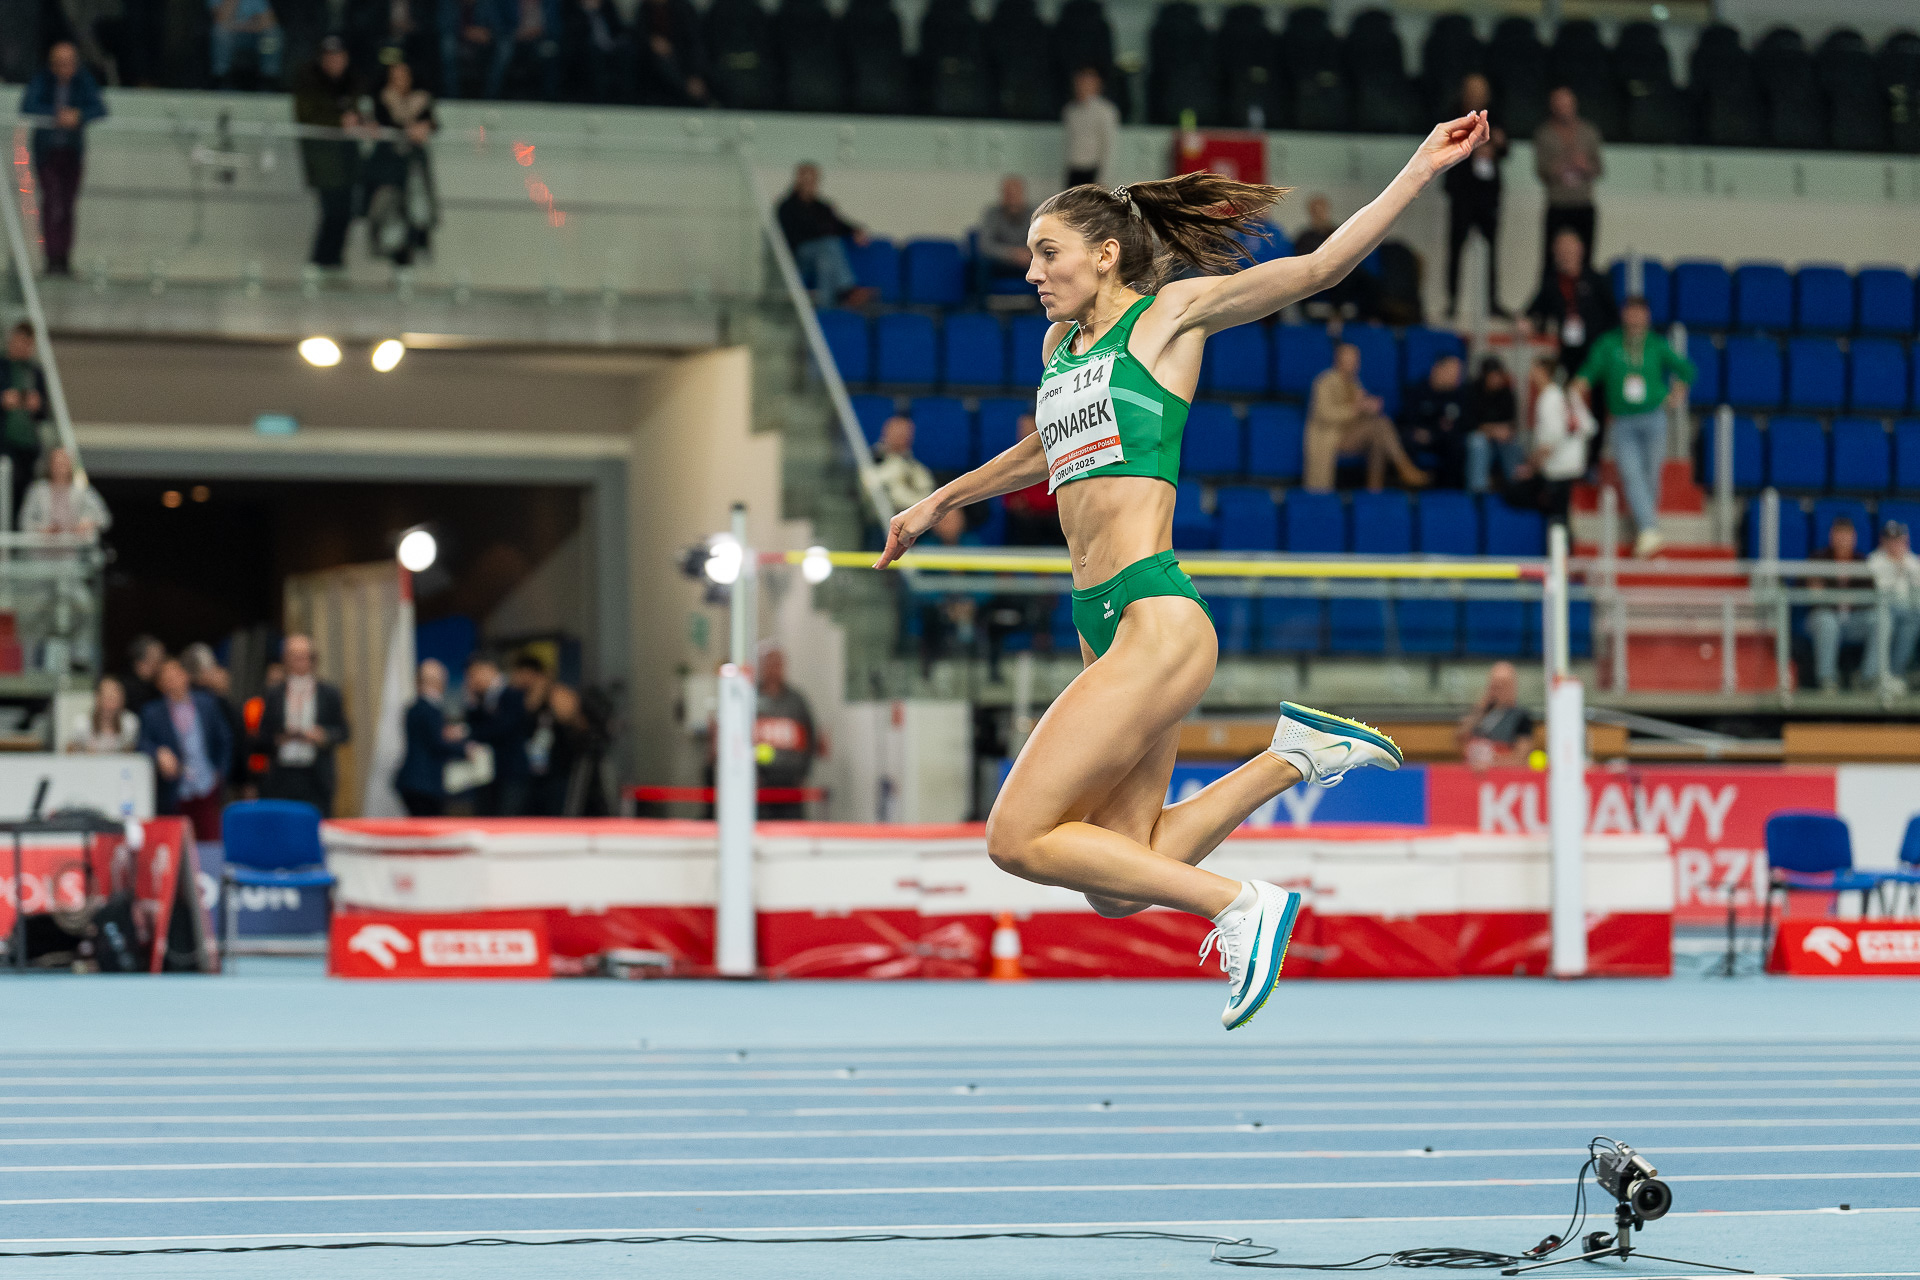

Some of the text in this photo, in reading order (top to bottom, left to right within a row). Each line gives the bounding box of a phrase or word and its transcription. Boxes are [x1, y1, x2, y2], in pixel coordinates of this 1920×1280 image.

[1073, 364, 1104, 394] 114
[1041, 399, 1112, 453] EDNAREK
[1097, 437, 1116, 449] Polski
[1075, 456, 1096, 471] 2025
[1479, 783, 1738, 842] KUAWY
